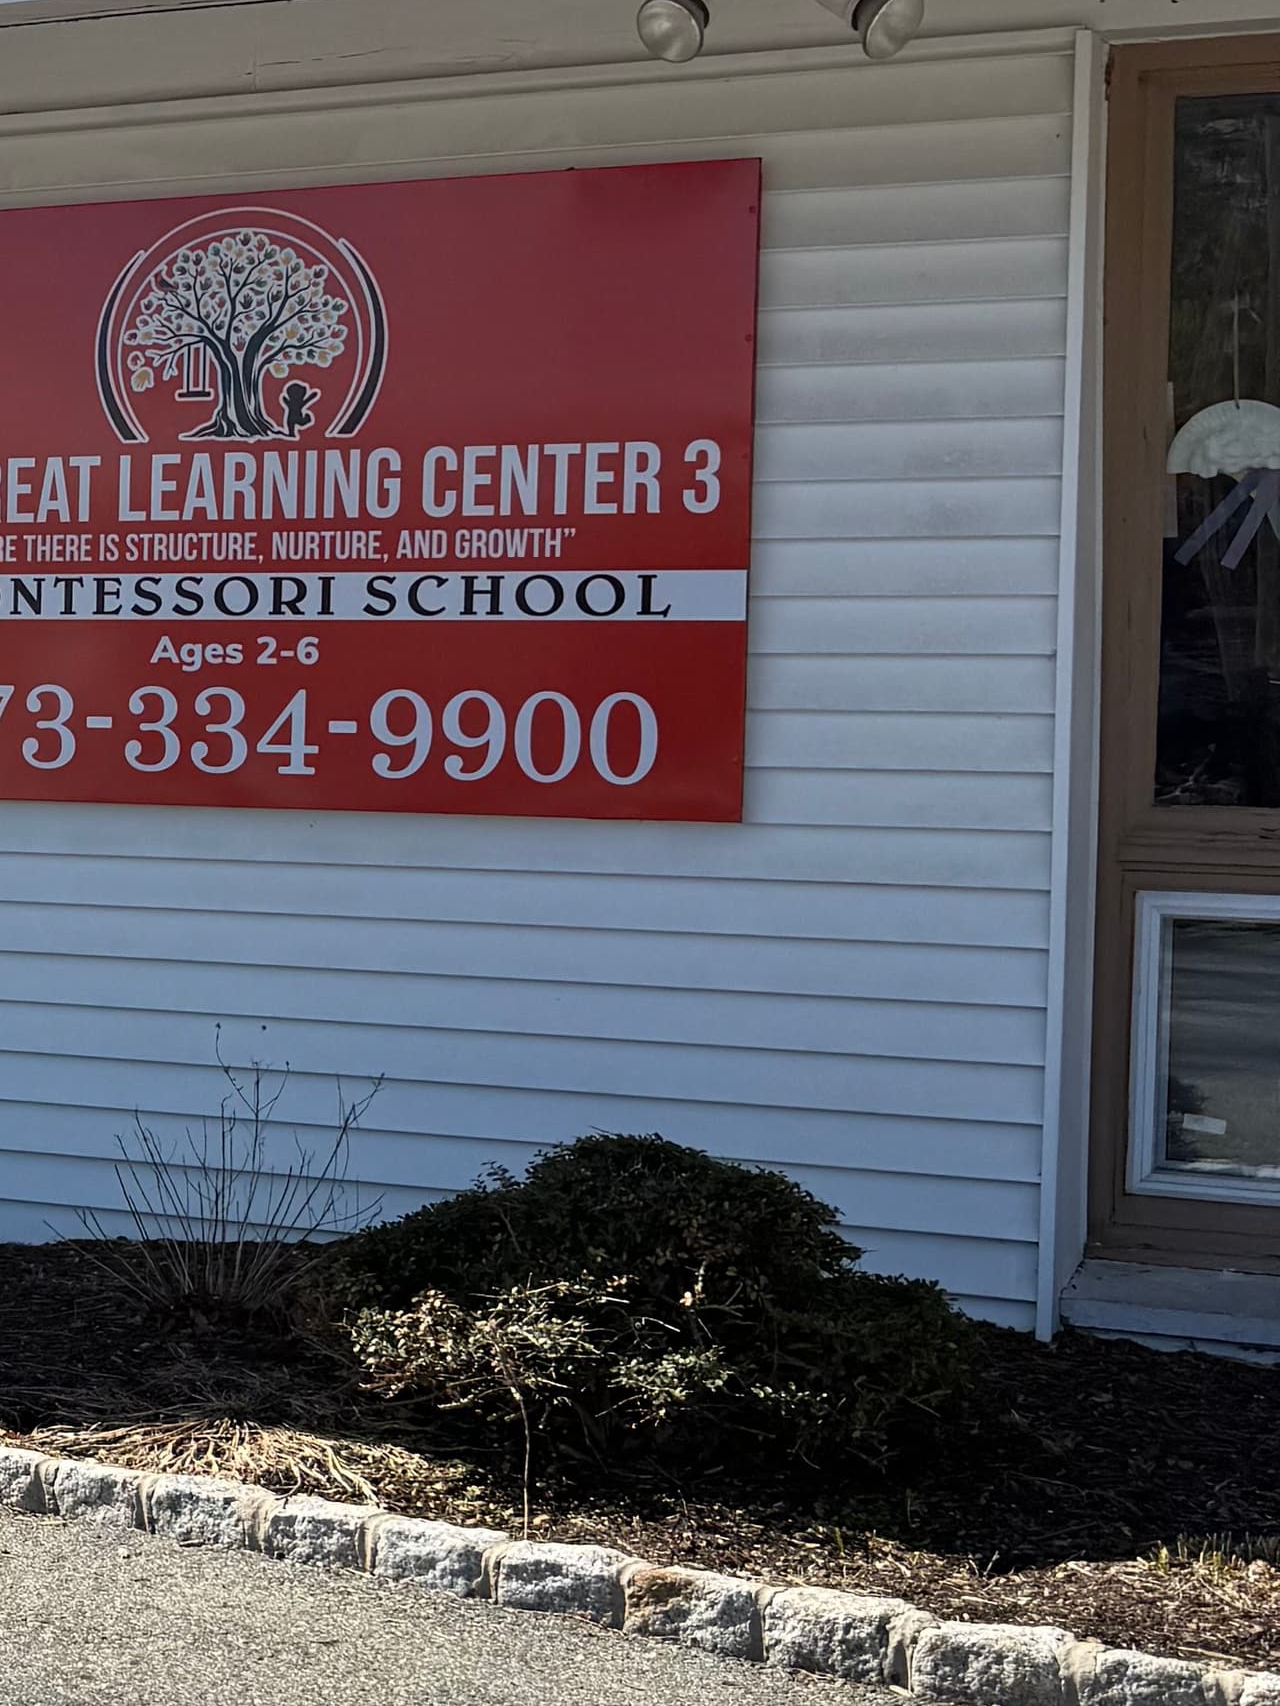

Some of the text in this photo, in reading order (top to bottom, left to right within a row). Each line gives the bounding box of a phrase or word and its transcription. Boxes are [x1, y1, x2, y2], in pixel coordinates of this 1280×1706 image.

[118, 446, 402, 521] LEARNING
[422, 441, 662, 518] CENTER
[682, 438, 722, 514] 3
[23, 533, 92, 562] THERE
[99, 533, 123, 563] IS
[125, 532, 264, 564] STRUCTURE,
[272, 530, 389, 563] NURTURE,
[396, 529, 447, 559] AND
[362, 574, 672, 618] SCHOOL
[150, 636, 320, 672] Ages 2-6
